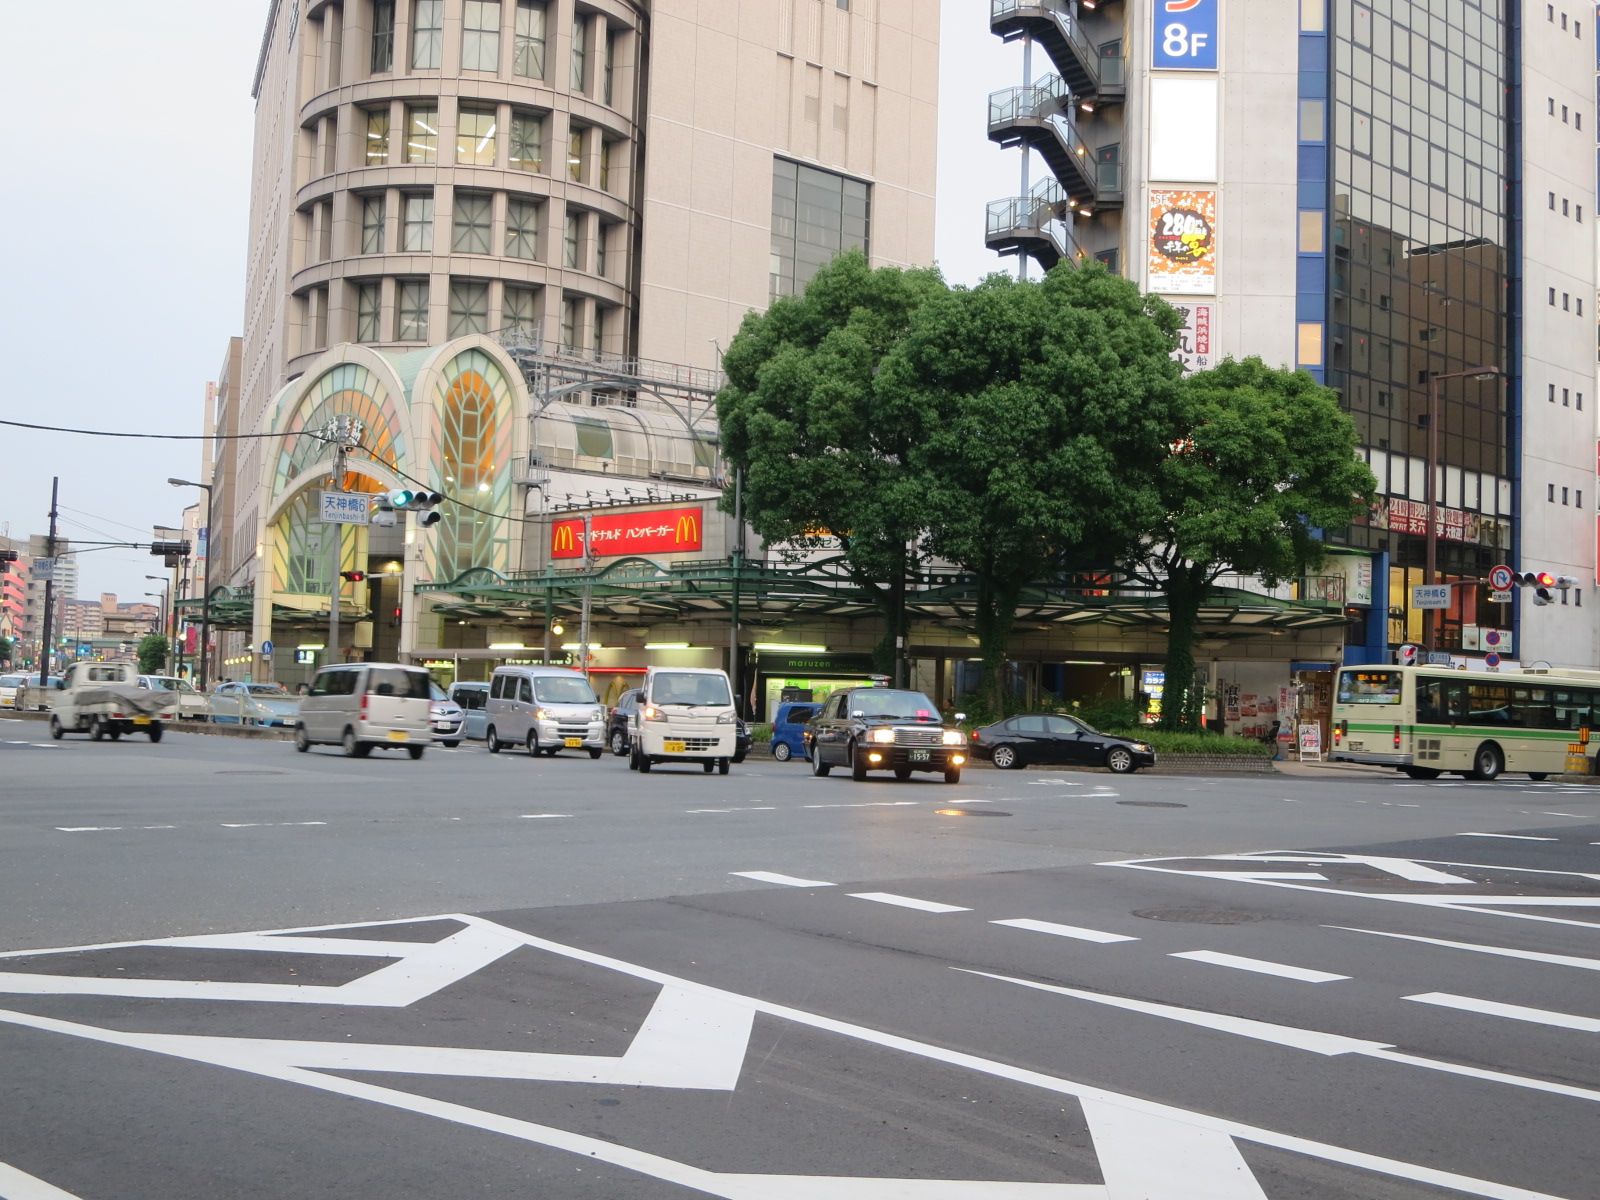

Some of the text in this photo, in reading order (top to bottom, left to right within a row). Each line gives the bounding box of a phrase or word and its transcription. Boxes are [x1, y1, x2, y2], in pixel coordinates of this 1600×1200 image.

[1163, 23, 1208, 57] 8F
[325, 496, 366, 513] 天神橋6
[576, 525, 675, 542] マドナルド ハンバーガー
[1409, 519, 1426, 534] 天六
[1415, 588, 1447, 598] 天神橋6
[788, 660, 831, 668] maruzen
